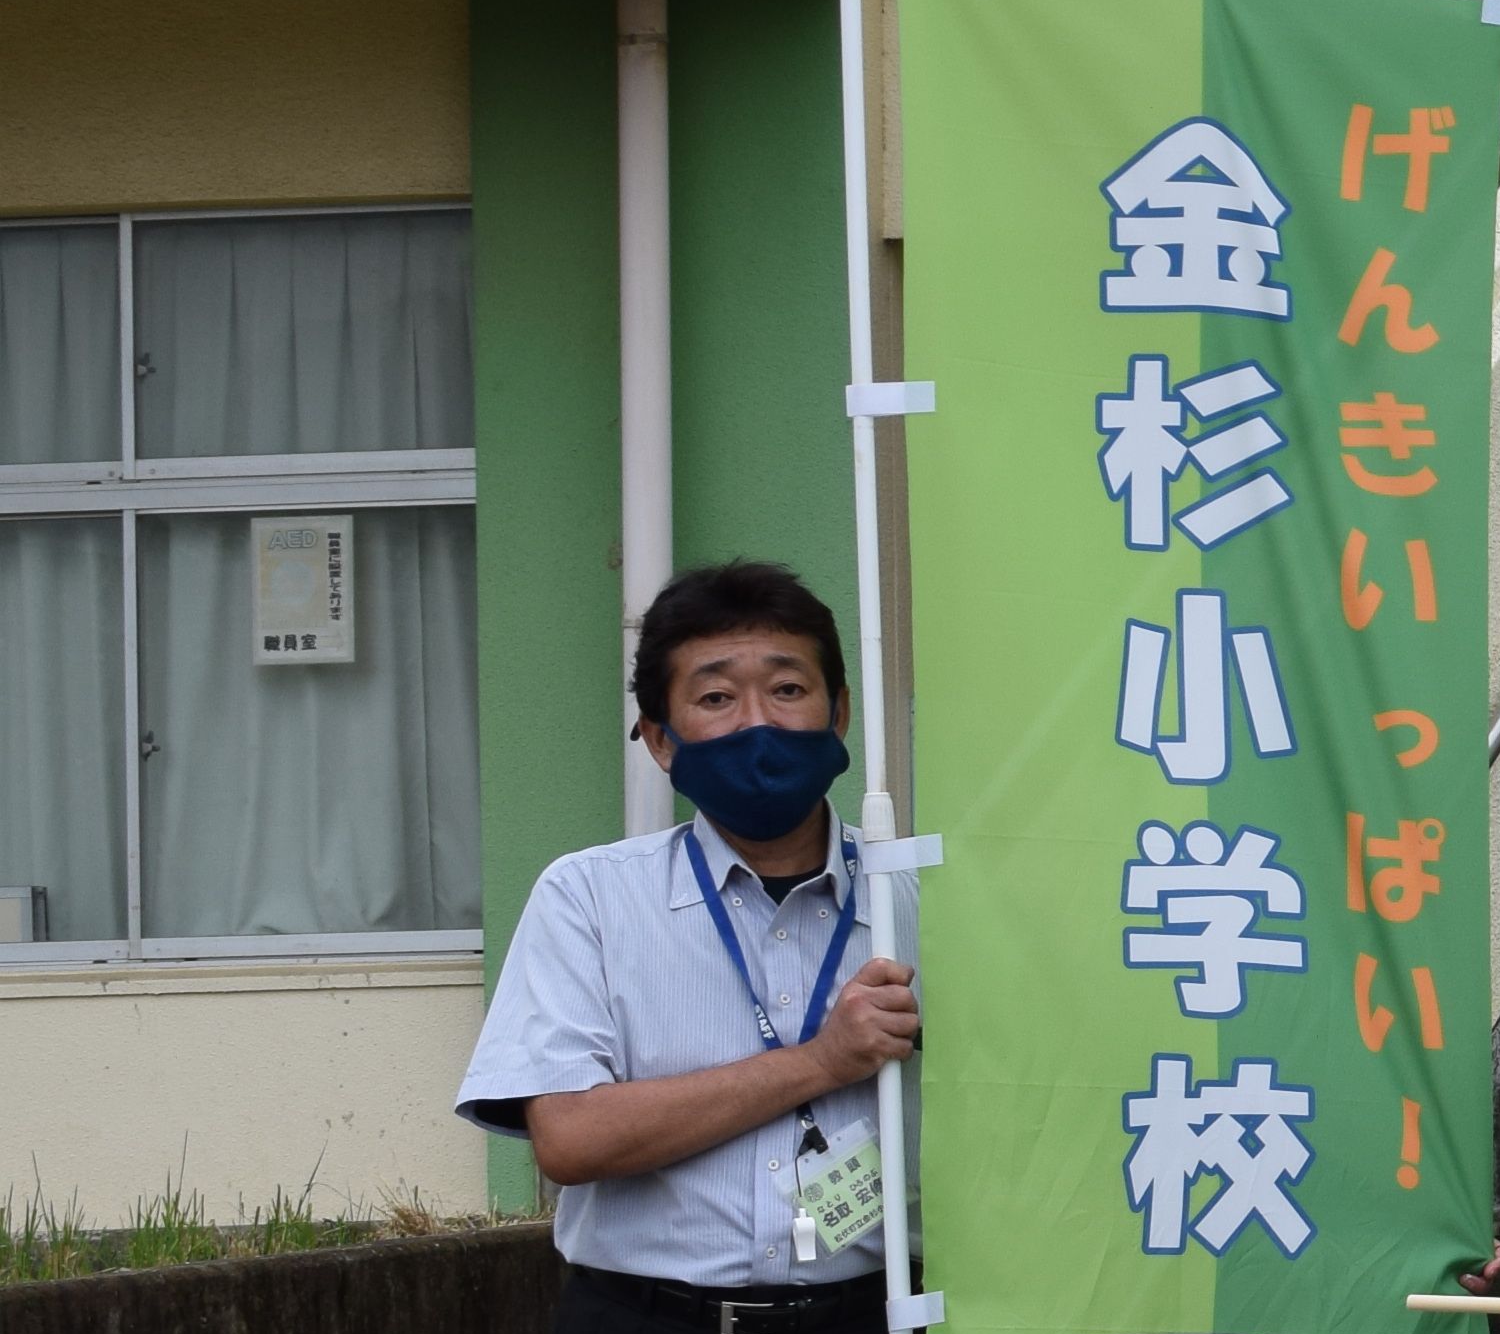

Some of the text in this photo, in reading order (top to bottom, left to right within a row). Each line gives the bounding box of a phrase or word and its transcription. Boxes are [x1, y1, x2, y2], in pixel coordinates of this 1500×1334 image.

[268, 530, 317, 549] AED
[264, 633, 317, 652] 職員室
[1095, 115, 1318, 1261] 金杉小学校
